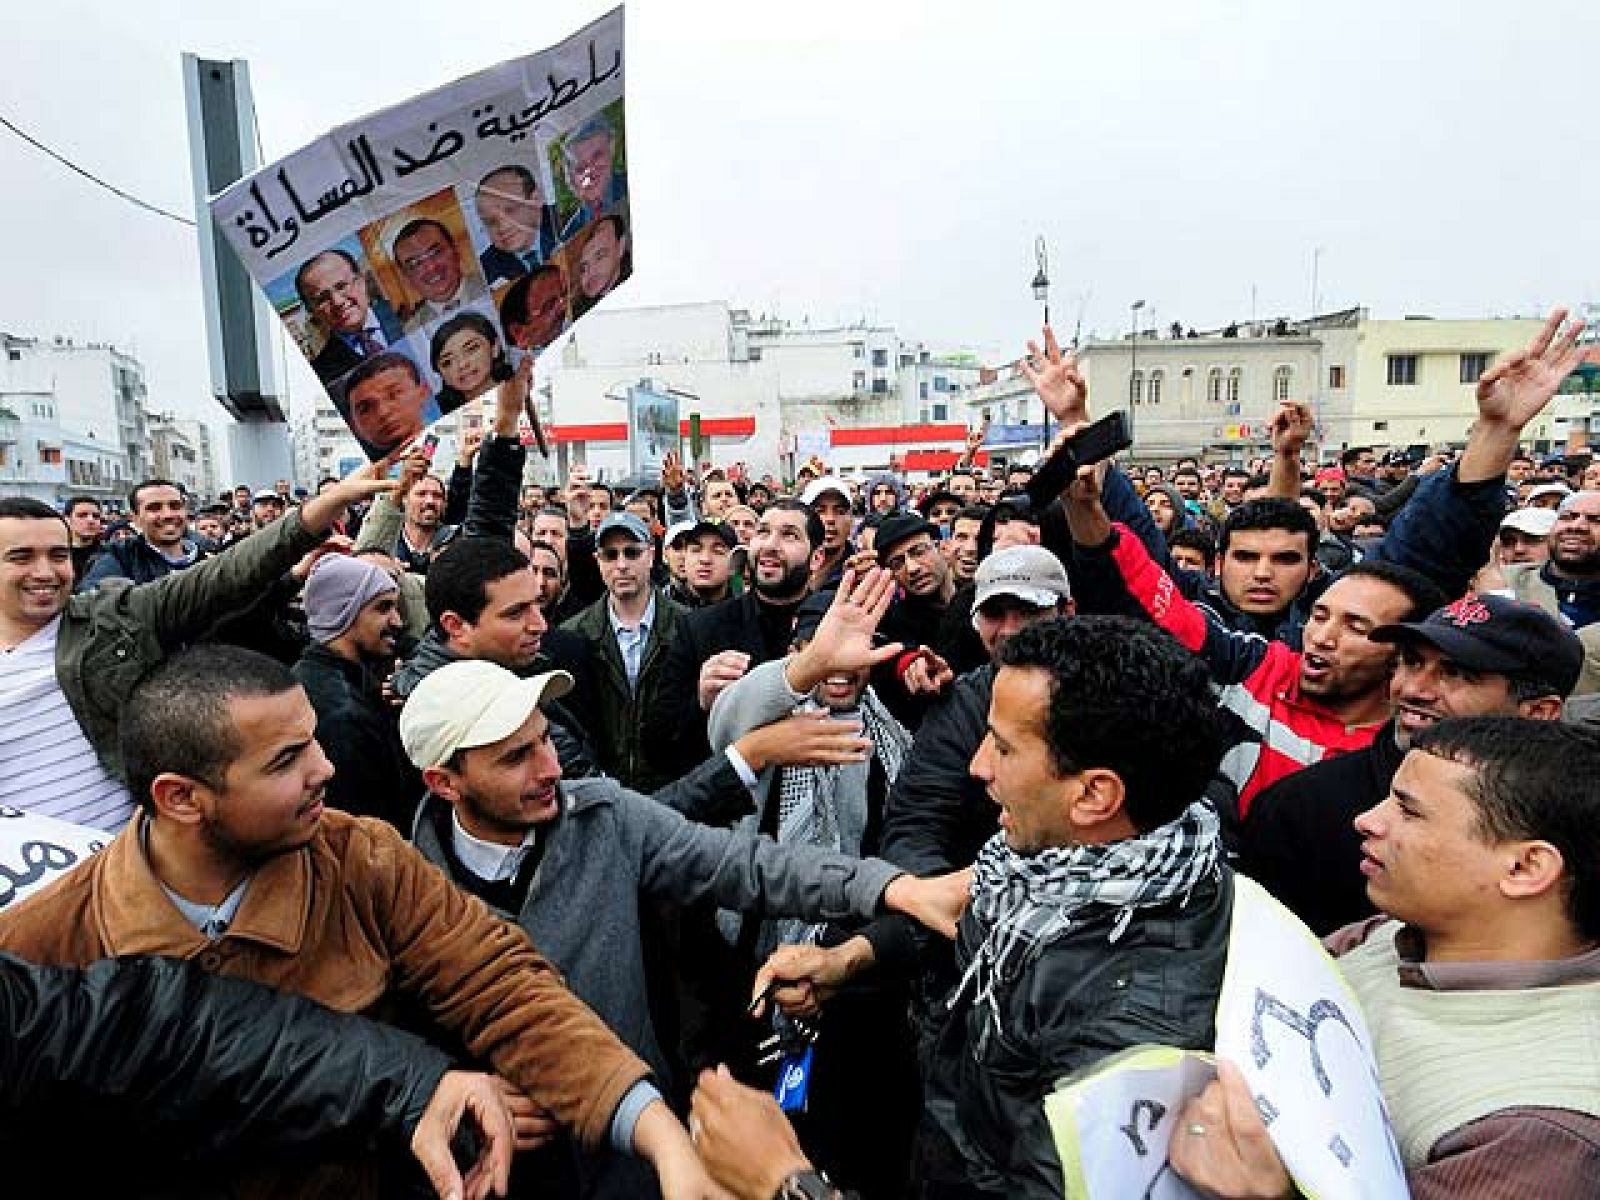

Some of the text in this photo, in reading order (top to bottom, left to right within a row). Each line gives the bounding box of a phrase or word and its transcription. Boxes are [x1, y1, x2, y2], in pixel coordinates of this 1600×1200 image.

[236, 40, 621, 260] بلطجية ضد المساواة
